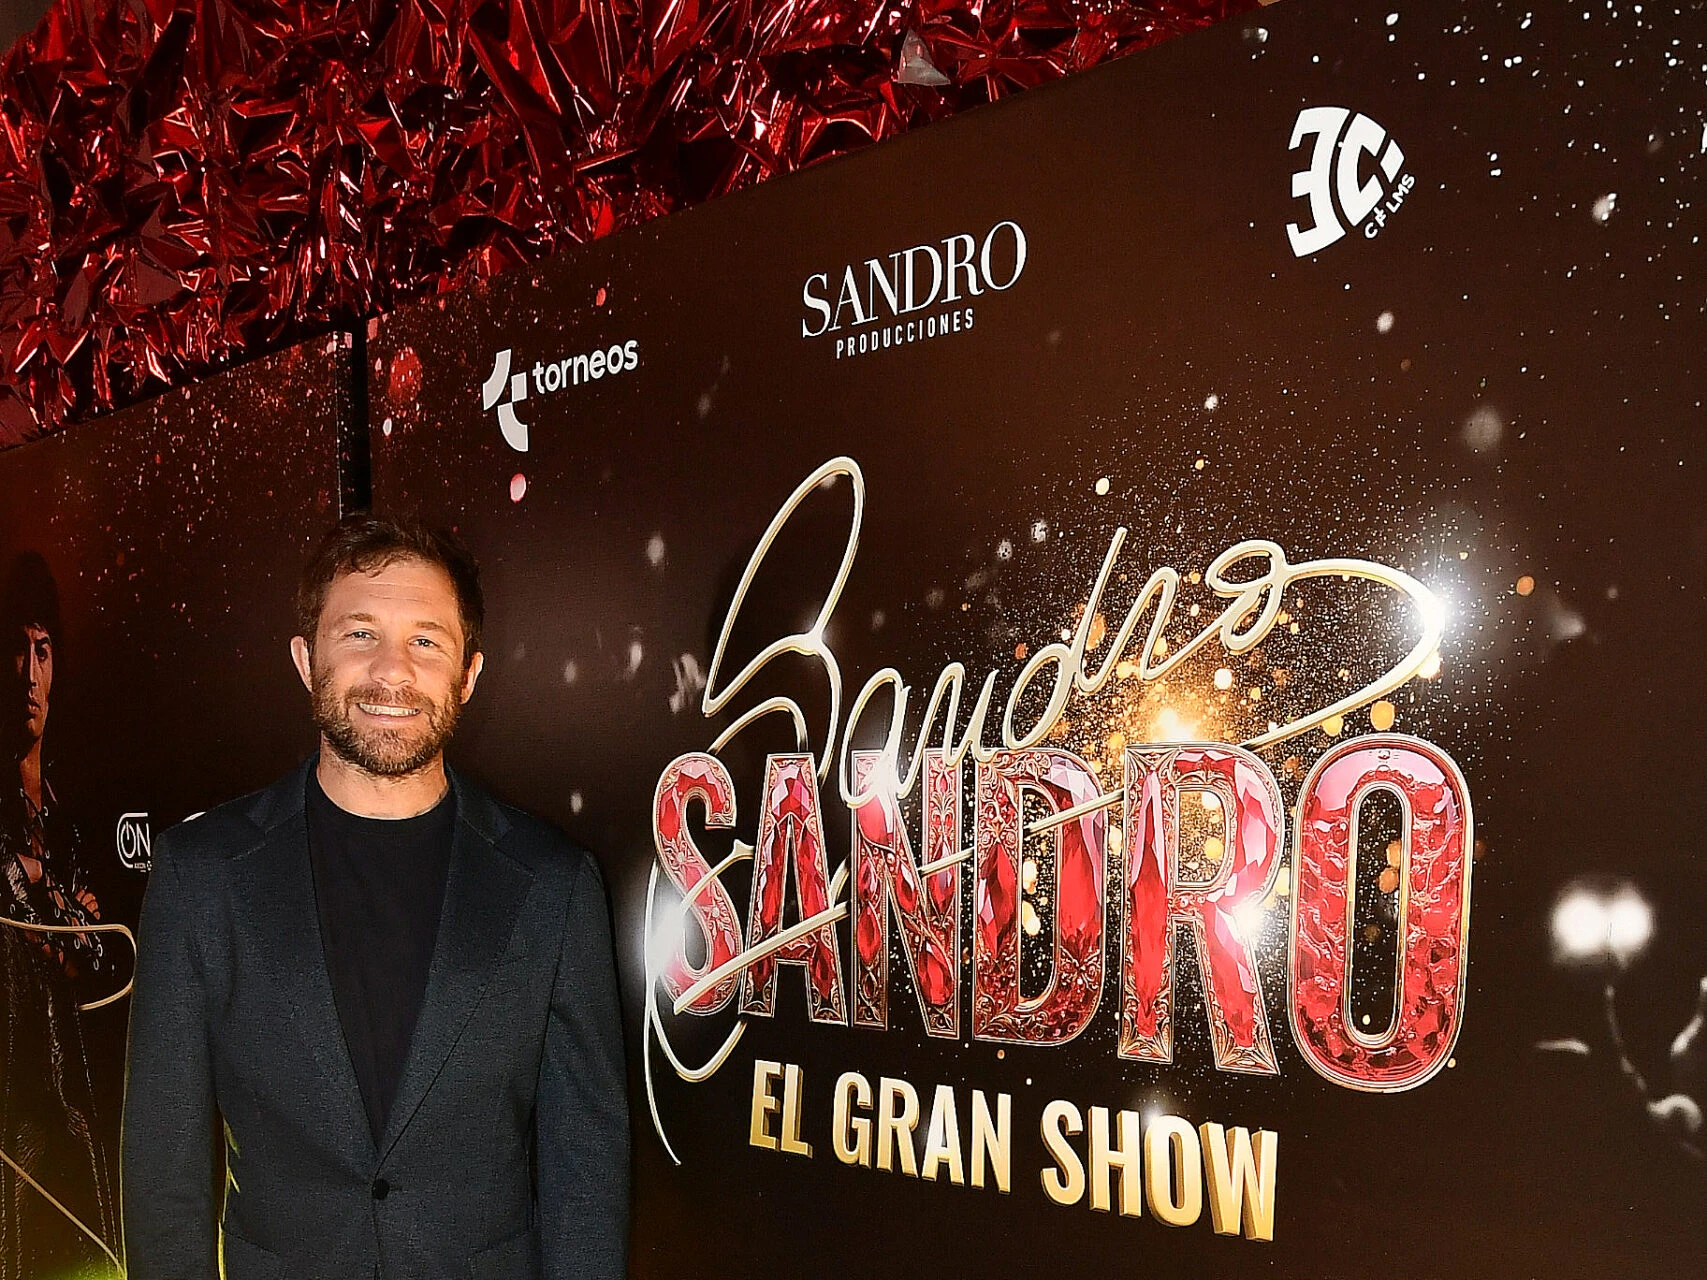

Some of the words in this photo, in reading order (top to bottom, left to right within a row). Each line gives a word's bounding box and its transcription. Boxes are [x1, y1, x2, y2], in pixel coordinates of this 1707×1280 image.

[802, 220, 1028, 338] SANDRO
[835, 308, 975, 360] PRODUCCIONES
[531, 338, 639, 394] torneos
[652, 733, 1476, 1094] SANDRO
[748, 1059, 814, 1159] EL
[832, 1070, 1012, 1195] GRAN
[1040, 1099, 1280, 1243] SHOW
